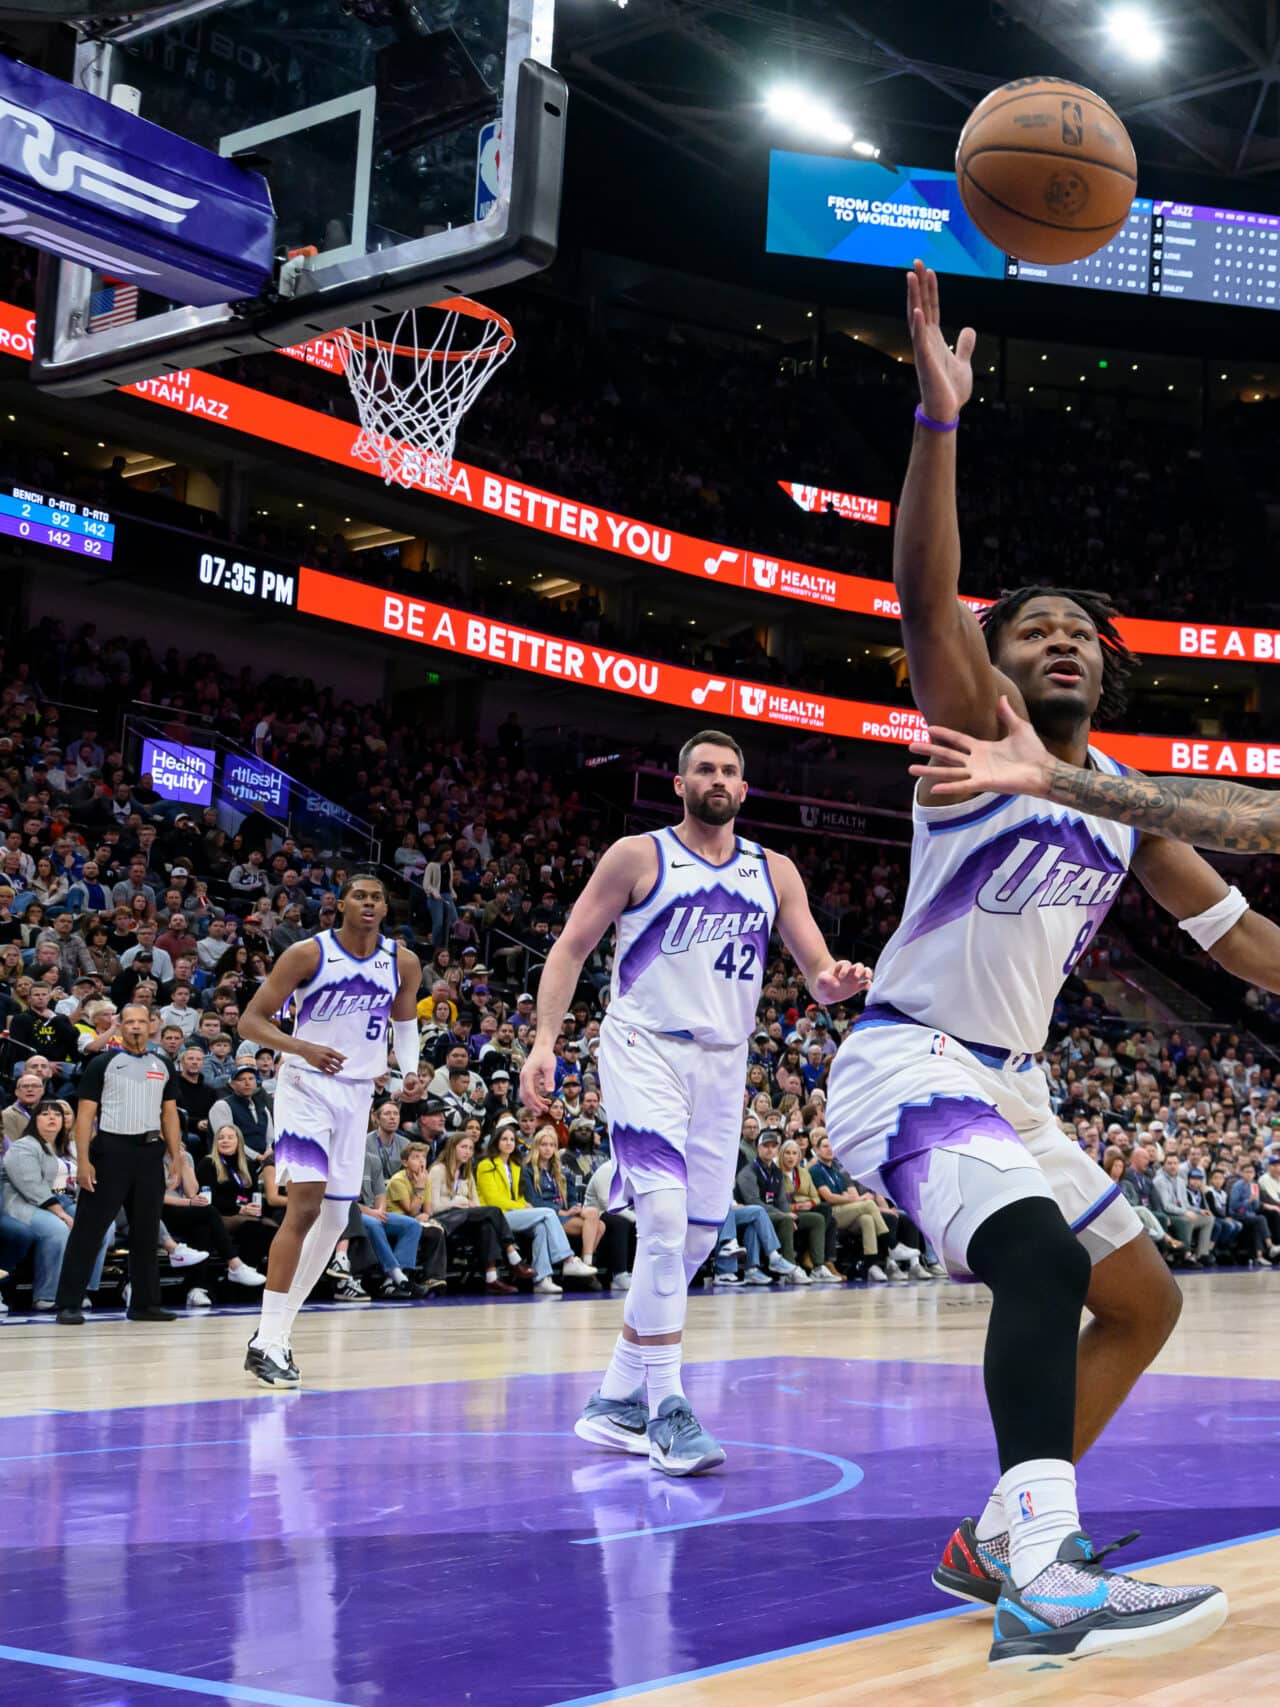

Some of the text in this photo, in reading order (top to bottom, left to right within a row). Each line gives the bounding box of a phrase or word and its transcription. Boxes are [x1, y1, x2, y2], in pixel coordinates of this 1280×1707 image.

[828, 195, 950, 221] FROM COURTSIDE
[834, 209, 942, 232] TO WORLDWIDE
[136, 380, 184, 405] UTAH
[185, 392, 229, 420] JAZZ
[13, 487, 44, 505] BENCH
[820, 490, 878, 515] HEALTH
[22, 504, 105, 537] 2 92 142
[450, 467, 472, 501] A
[482, 476, 599, 542] BETTER
[605, 516, 672, 562] YOU
[19, 523, 101, 555] 0 142 92
[200, 554, 294, 605] 07:35 PM
[781, 569, 836, 595] HEALTH
[383, 596, 659, 694] BE A BETTER YOU
[1180, 627, 1217, 654] BE
[1223, 631, 1245, 656] A
[769, 695, 825, 719] HEALTH
[889, 712, 928, 729] OFFIC
[862, 722, 930, 744] PROVIDER
[152, 750, 206, 774] Health
[1172, 742, 1208, 769] BE
[1215, 746, 1238, 772] A
[822, 812, 866, 829] HEALTH
[976, 837, 1128, 915] UTAH
[660, 906, 768, 955] UTAH
[714, 942, 756, 981] 42
[310, 990, 391, 1022] UTAH
[366, 1016, 383, 1041] 5
